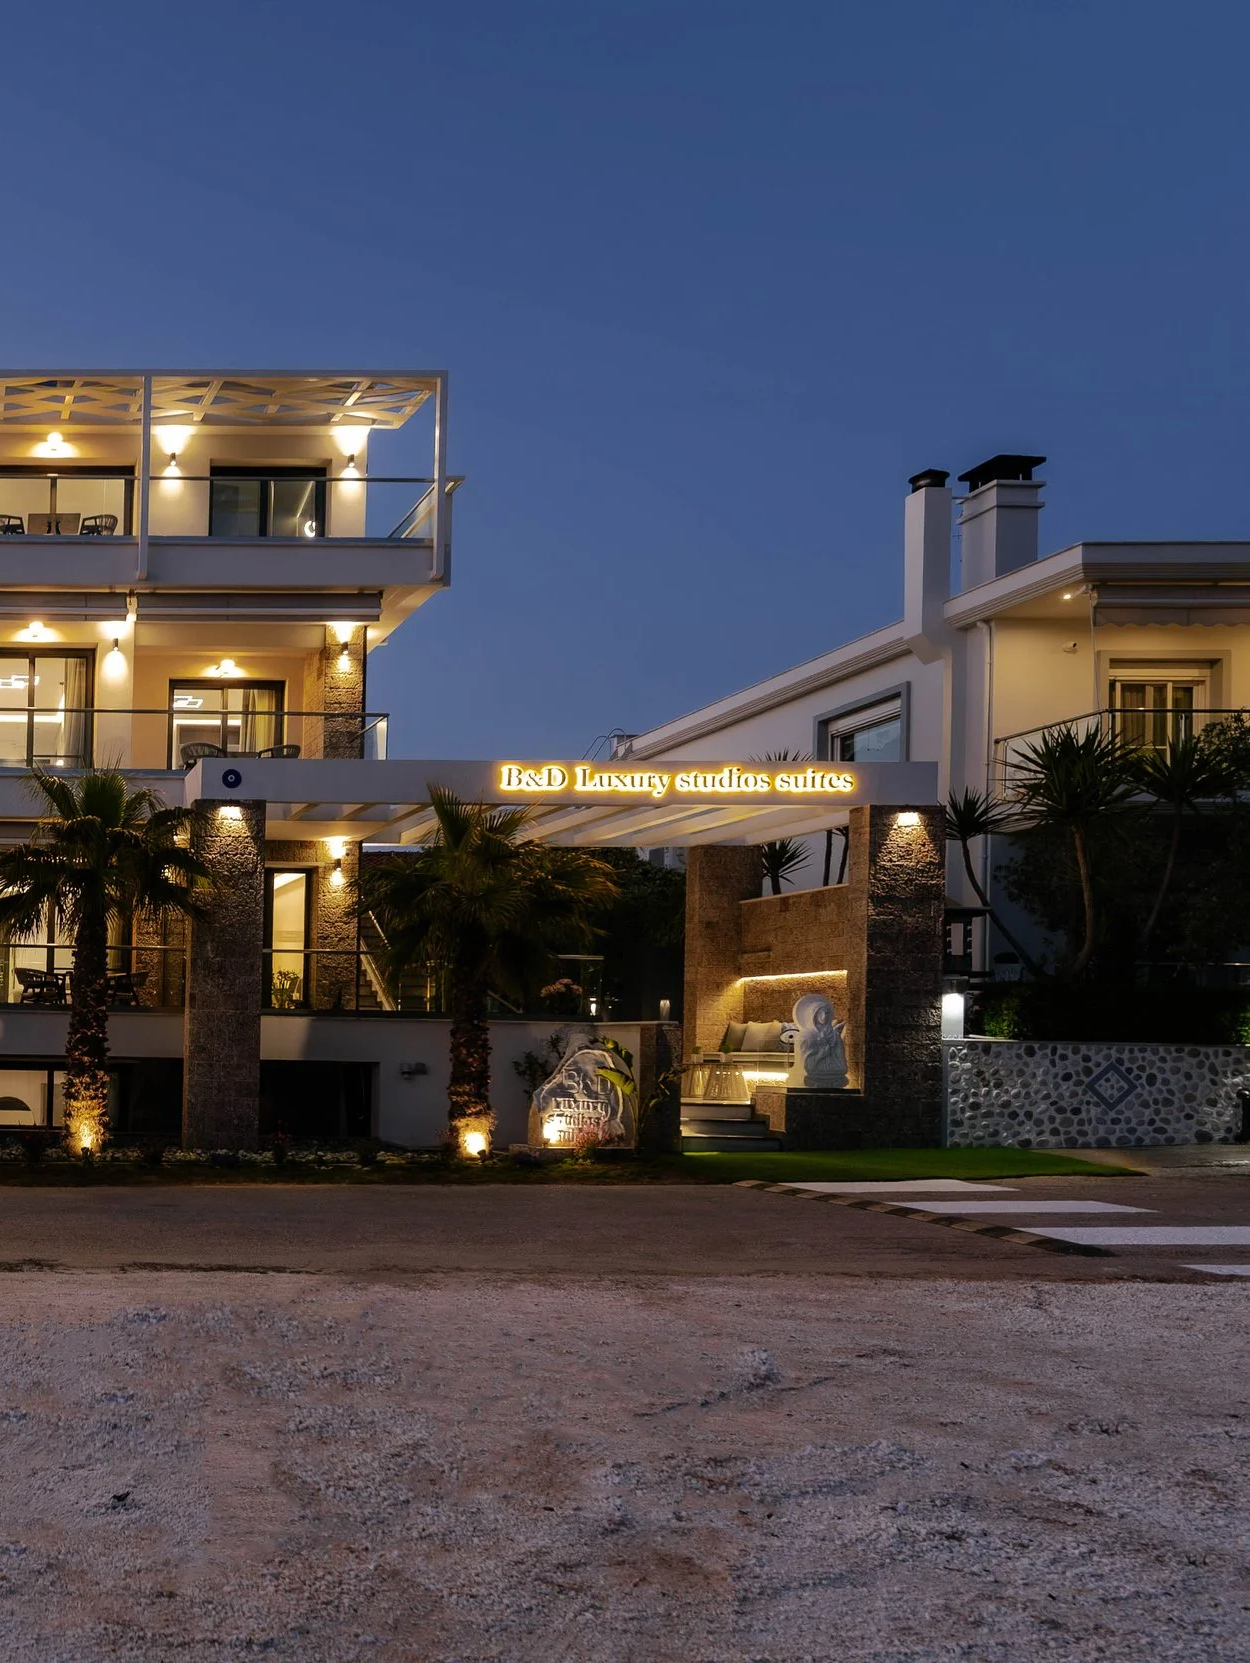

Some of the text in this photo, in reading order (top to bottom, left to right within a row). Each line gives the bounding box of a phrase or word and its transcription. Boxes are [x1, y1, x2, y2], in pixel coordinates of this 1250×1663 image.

[502, 765, 855, 796] B&D Luxury studios suites
